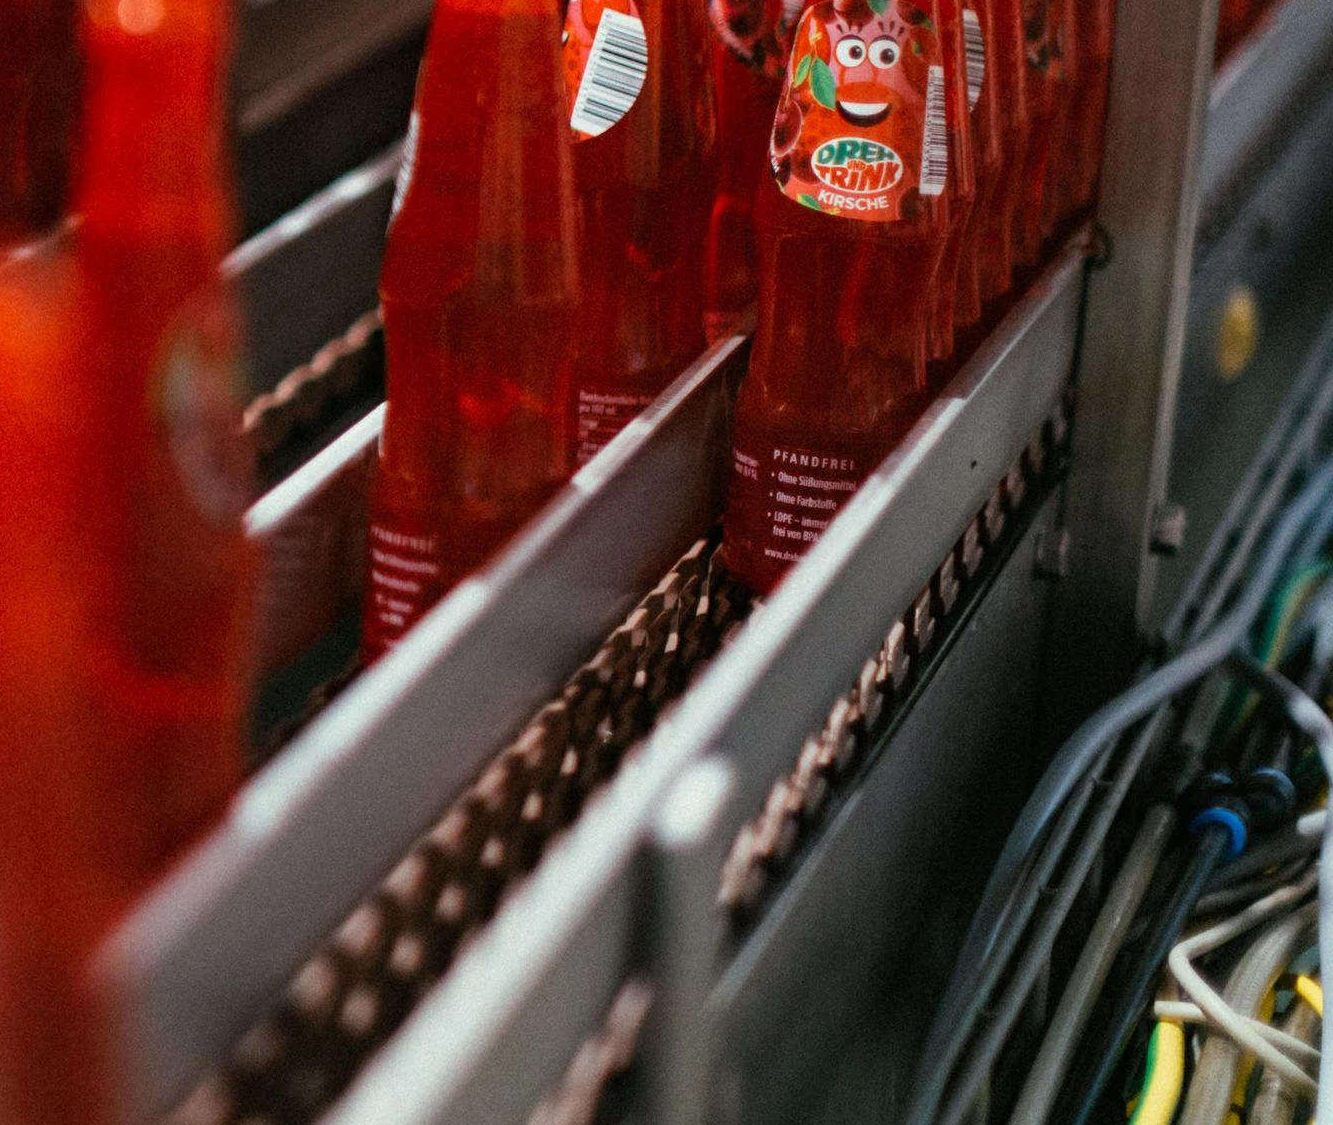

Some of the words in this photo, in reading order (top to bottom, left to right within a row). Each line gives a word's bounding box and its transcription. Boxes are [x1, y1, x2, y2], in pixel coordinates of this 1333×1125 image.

[817, 140, 895, 165] DREH
[815, 162, 900, 192] TRINK
[818, 189, 889, 210] KIRSCHE
[773, 449, 854, 470] PFANDFREI
[778, 471, 797, 485] Ohne
[799, 475, 857, 491] Süßungsmittel
[776, 491, 795, 505] Ohne
[797, 495, 837, 510] Farbstoffe
[774, 511, 793, 524] LDPE
[773, 524, 786, 538] frei
[787, 529, 801, 540] von
